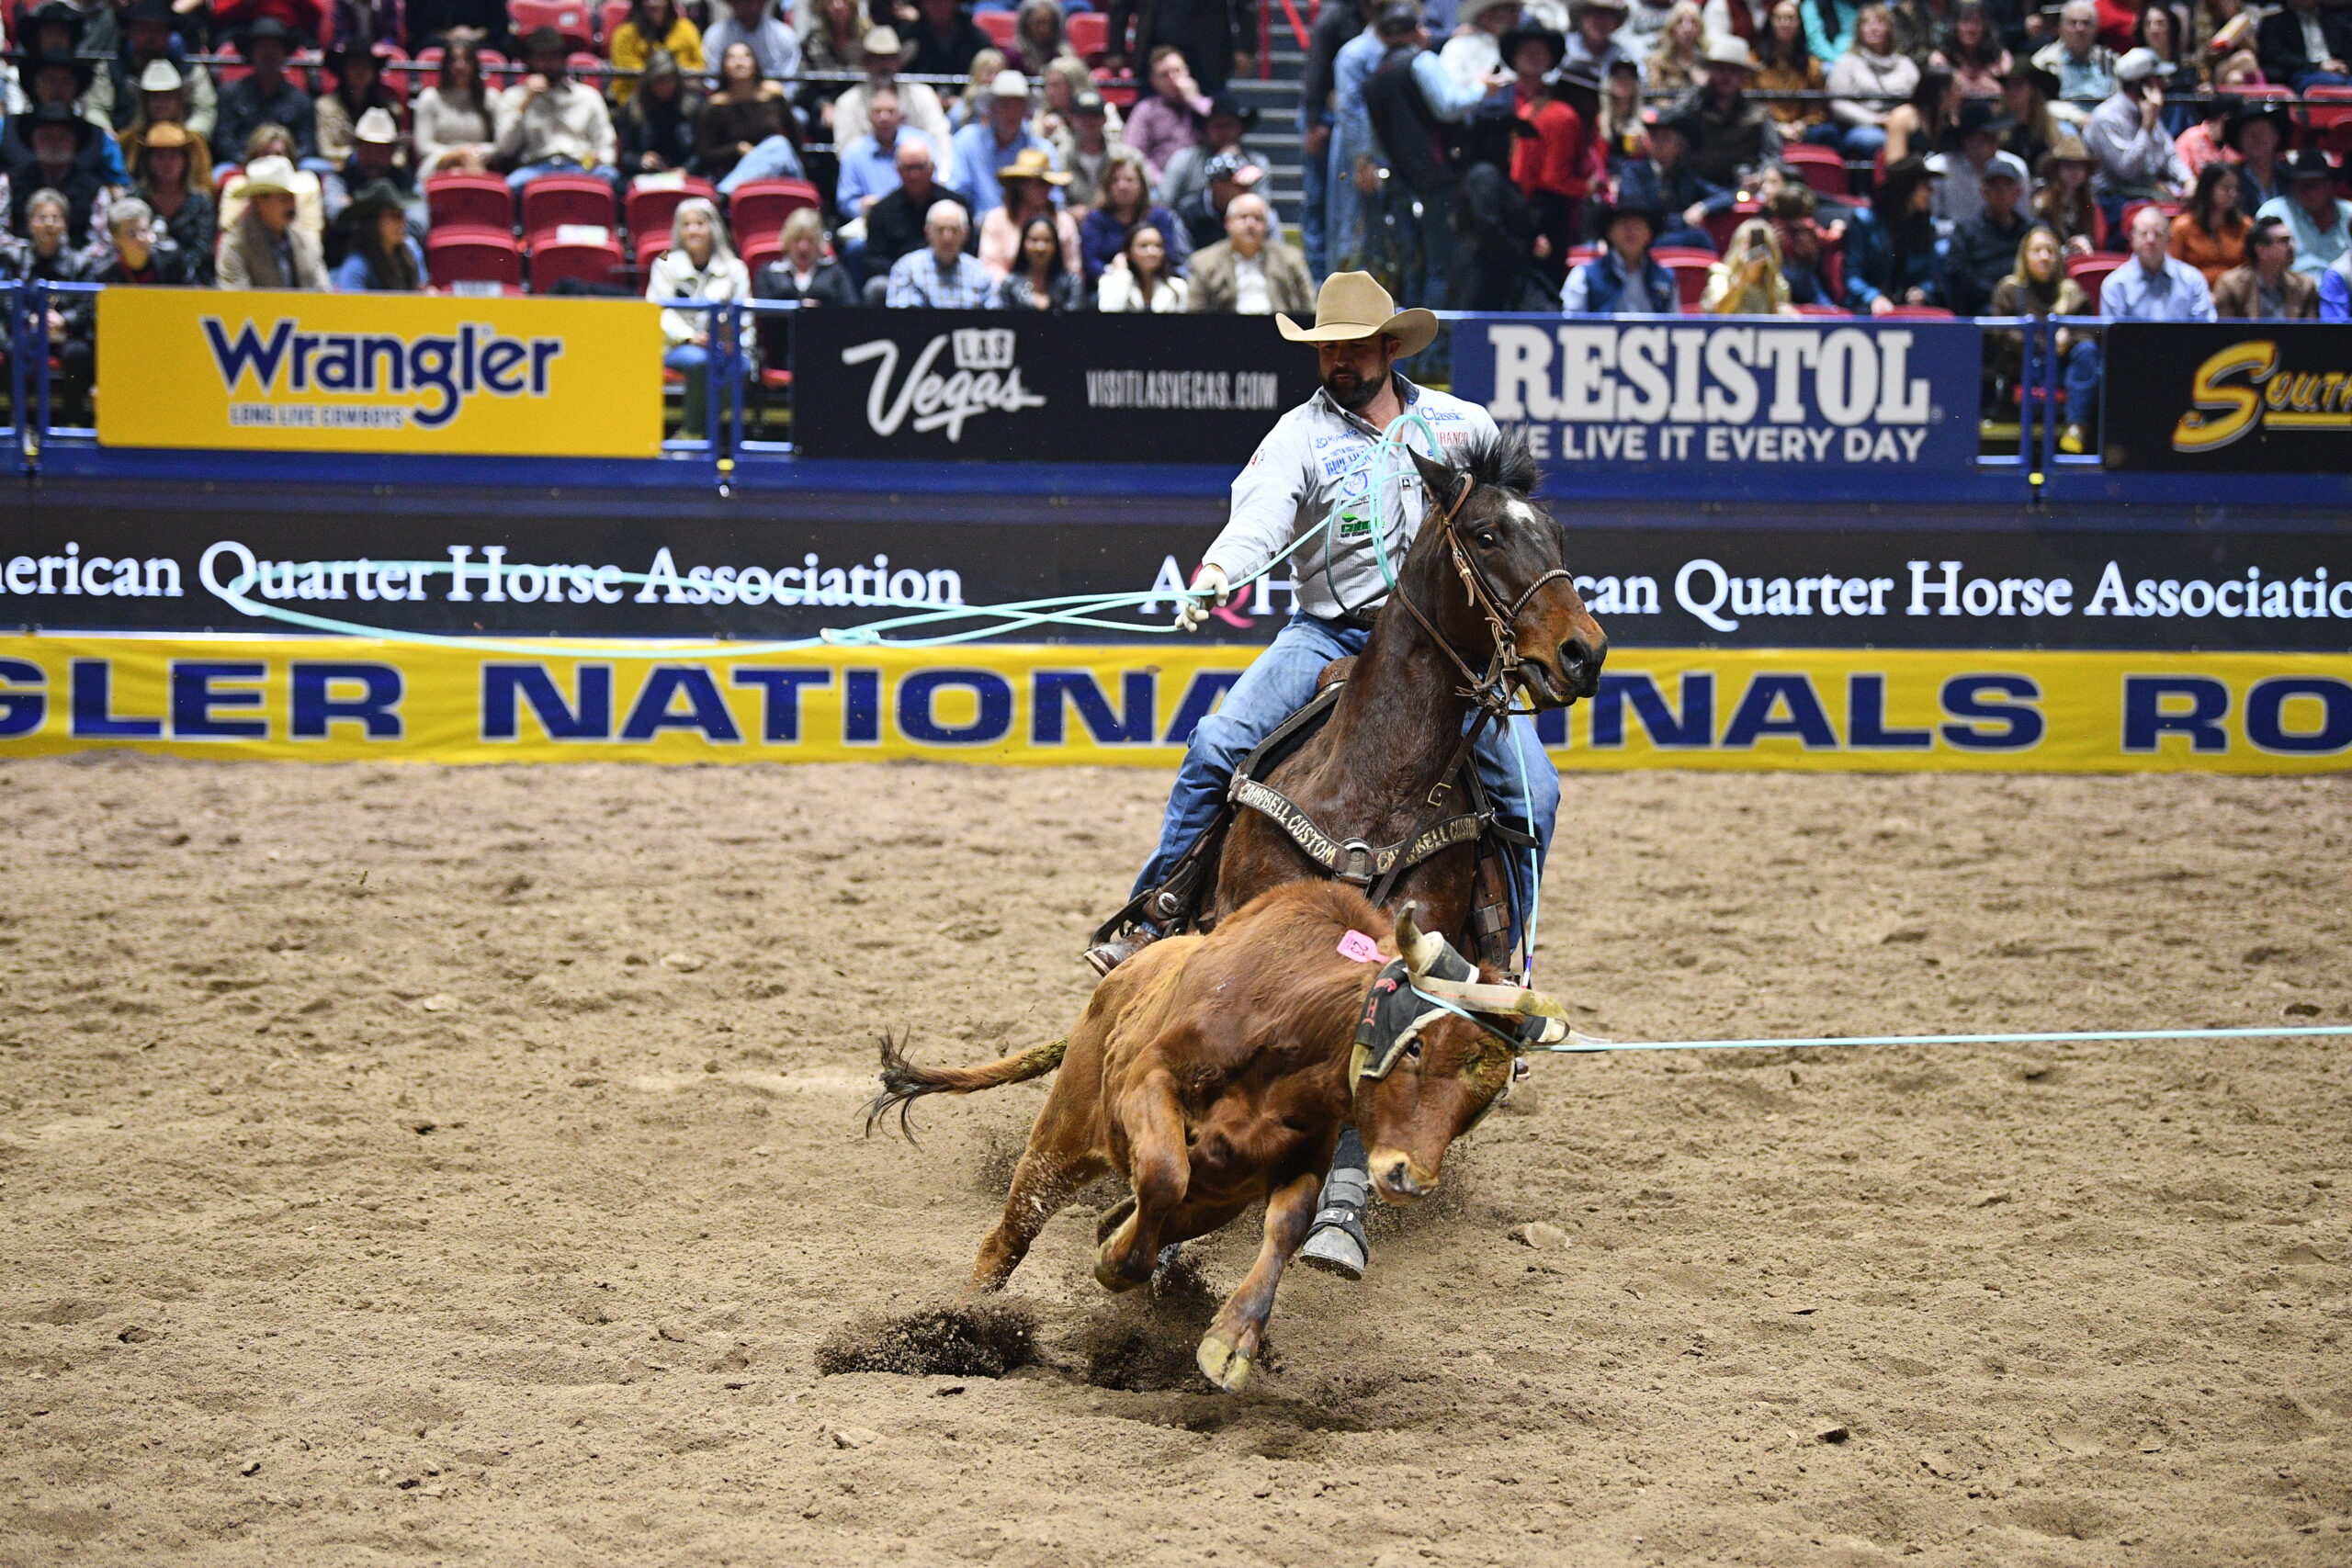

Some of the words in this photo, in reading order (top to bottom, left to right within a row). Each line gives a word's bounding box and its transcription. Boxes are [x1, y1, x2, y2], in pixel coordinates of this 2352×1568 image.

[200, 316, 562, 428] Wrangler
[959, 335, 1007, 362] LAS
[1487, 325, 1931, 426] RESISTOL
[230, 404, 275, 425] LONG
[278, 405, 317, 426] LIVE
[321, 405, 404, 427] COWBOYS
[842, 334, 1047, 443] Vegas
[1086, 370, 1278, 409] VISITLASVEGAS.COM
[1421, 407, 1465, 421] Classic
[1563, 425, 1646, 459] LIVE
[1659, 426, 1695, 459] IT
[1706, 426, 1835, 461] EVERY
[1843, 427, 1928, 462] DAY
[0, 541, 184, 596] erican
[199, 540, 433, 616] Quarter
[447, 545, 623, 604] Horse
[634, 547, 964, 606] Association
[1674, 558, 1894, 633] Quarter
[1905, 560, 2073, 617] Horse
[1238, 783, 1291, 824] CAMPBELL
[1287, 815, 1337, 865] CUSTOM
[1377, 825, 1450, 873] CABELL
